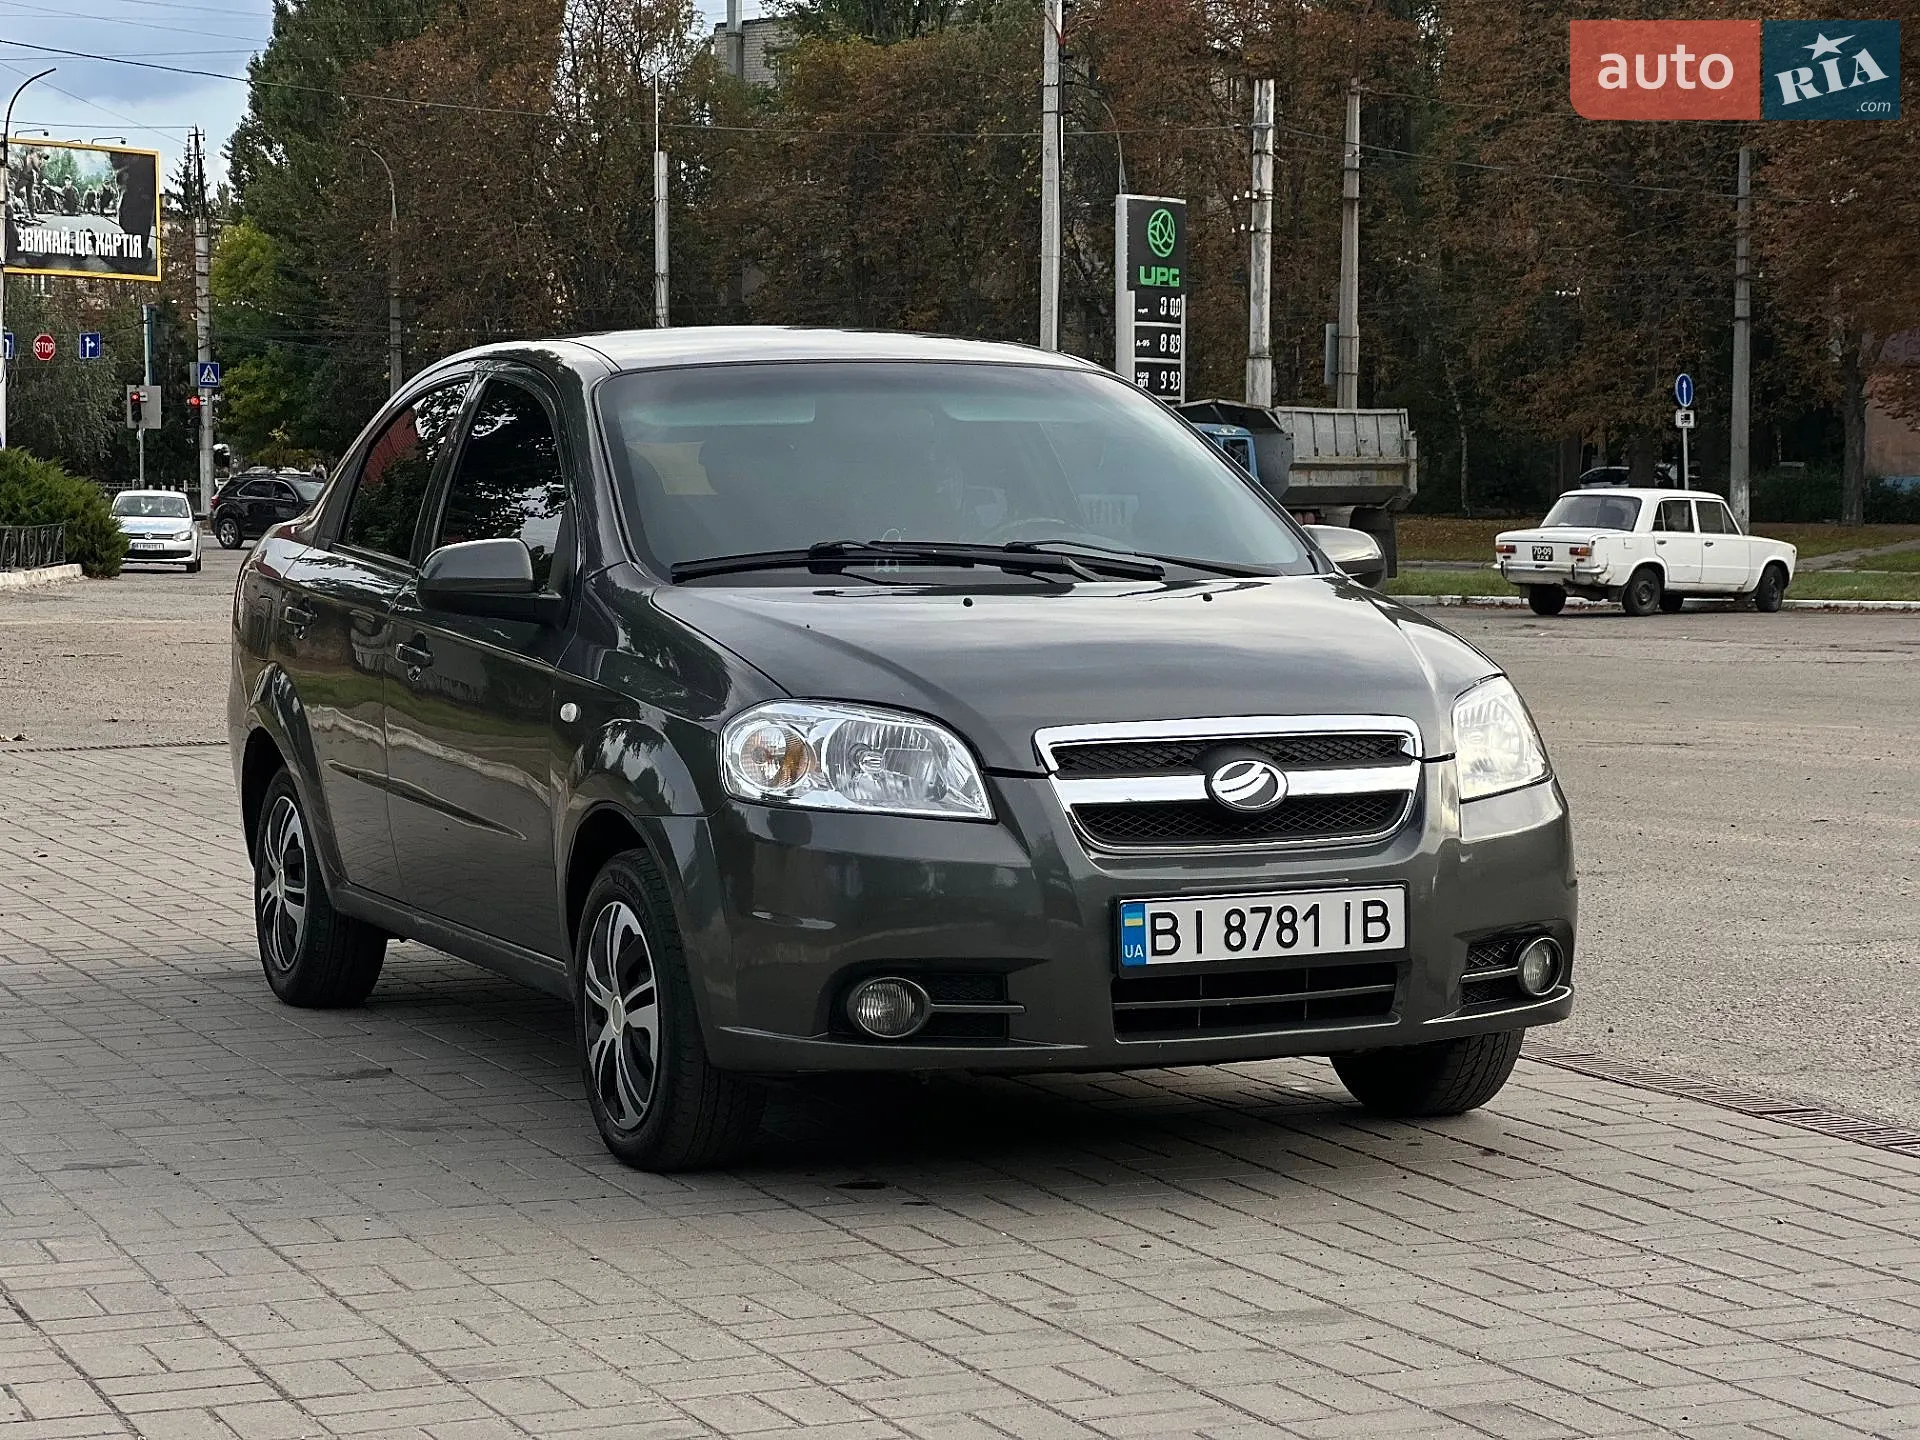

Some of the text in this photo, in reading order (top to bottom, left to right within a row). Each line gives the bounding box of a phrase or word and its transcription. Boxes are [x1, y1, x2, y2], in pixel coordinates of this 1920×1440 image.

[17, 227, 143, 259] ЗВИКАЙ, ЦЕ ХАРТІЯ
[1140, 265, 1180, 287] UPG
[35, 341, 54, 354] STOP
[1150, 899, 1391, 956] BI 8781 IB
[1124, 944, 1144, 958] UA
